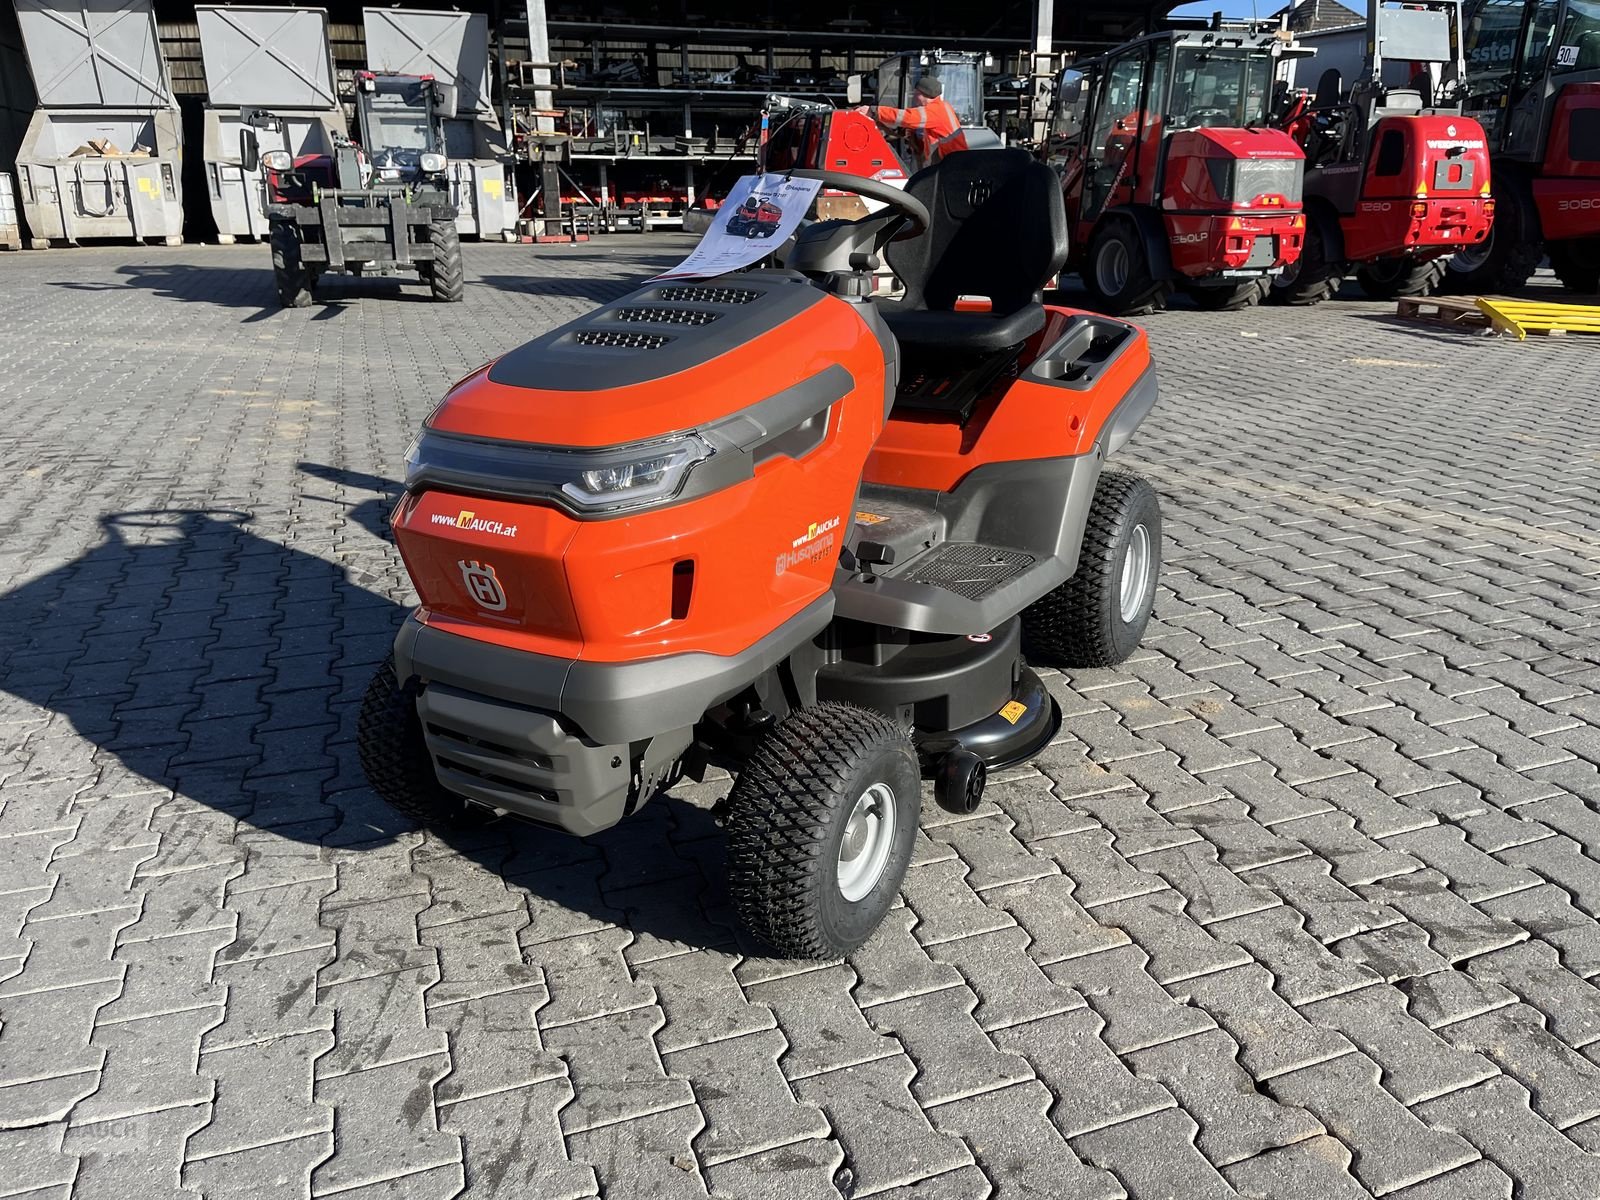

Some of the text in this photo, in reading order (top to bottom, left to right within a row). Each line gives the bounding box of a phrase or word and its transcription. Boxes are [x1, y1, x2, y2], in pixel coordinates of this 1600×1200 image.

[1557, 48, 1571, 63] 30
[431, 512, 518, 538] www.MAUCH.at
[792, 515, 840, 549] www.MAUCH.at
[787, 532, 834, 568] Husqvarna
